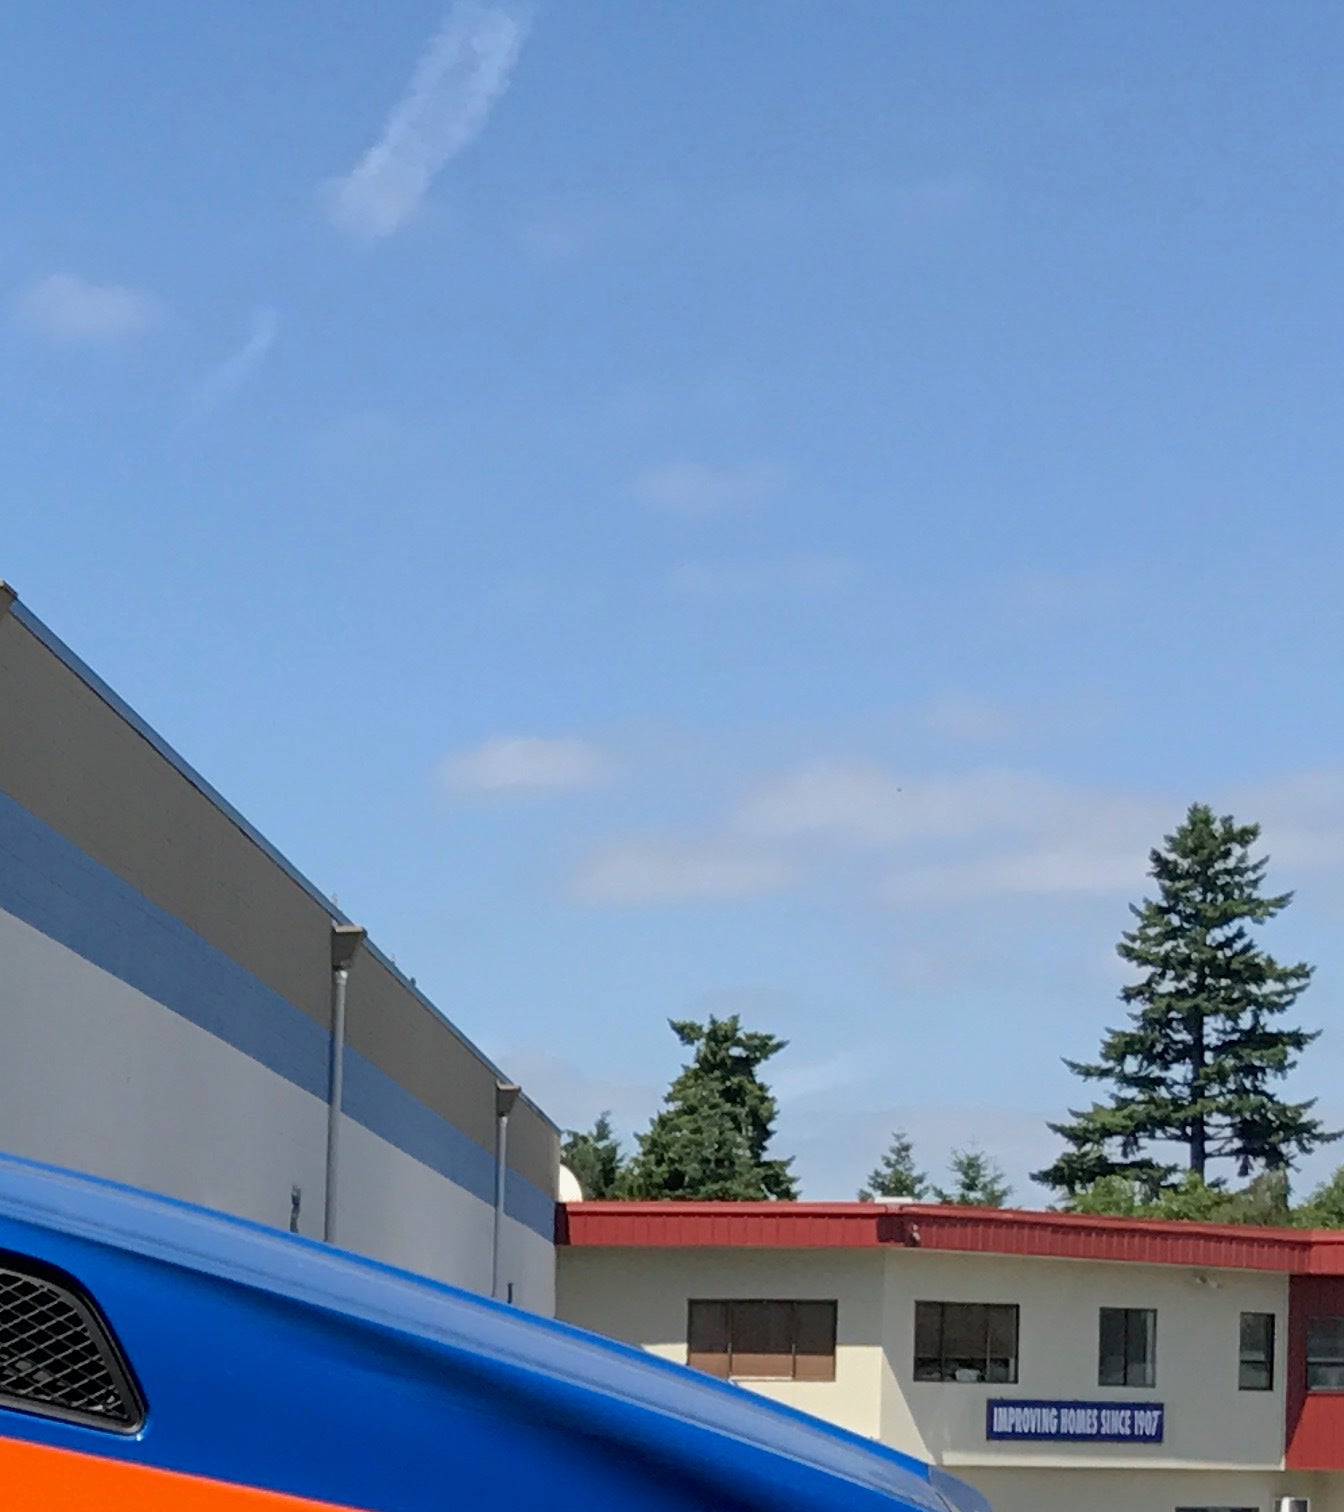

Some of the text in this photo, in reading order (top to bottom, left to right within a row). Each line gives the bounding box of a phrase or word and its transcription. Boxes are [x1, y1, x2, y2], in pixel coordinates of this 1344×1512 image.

[993, 1406, 1162, 1437] IMPROVING HOMES SINCE 1907
